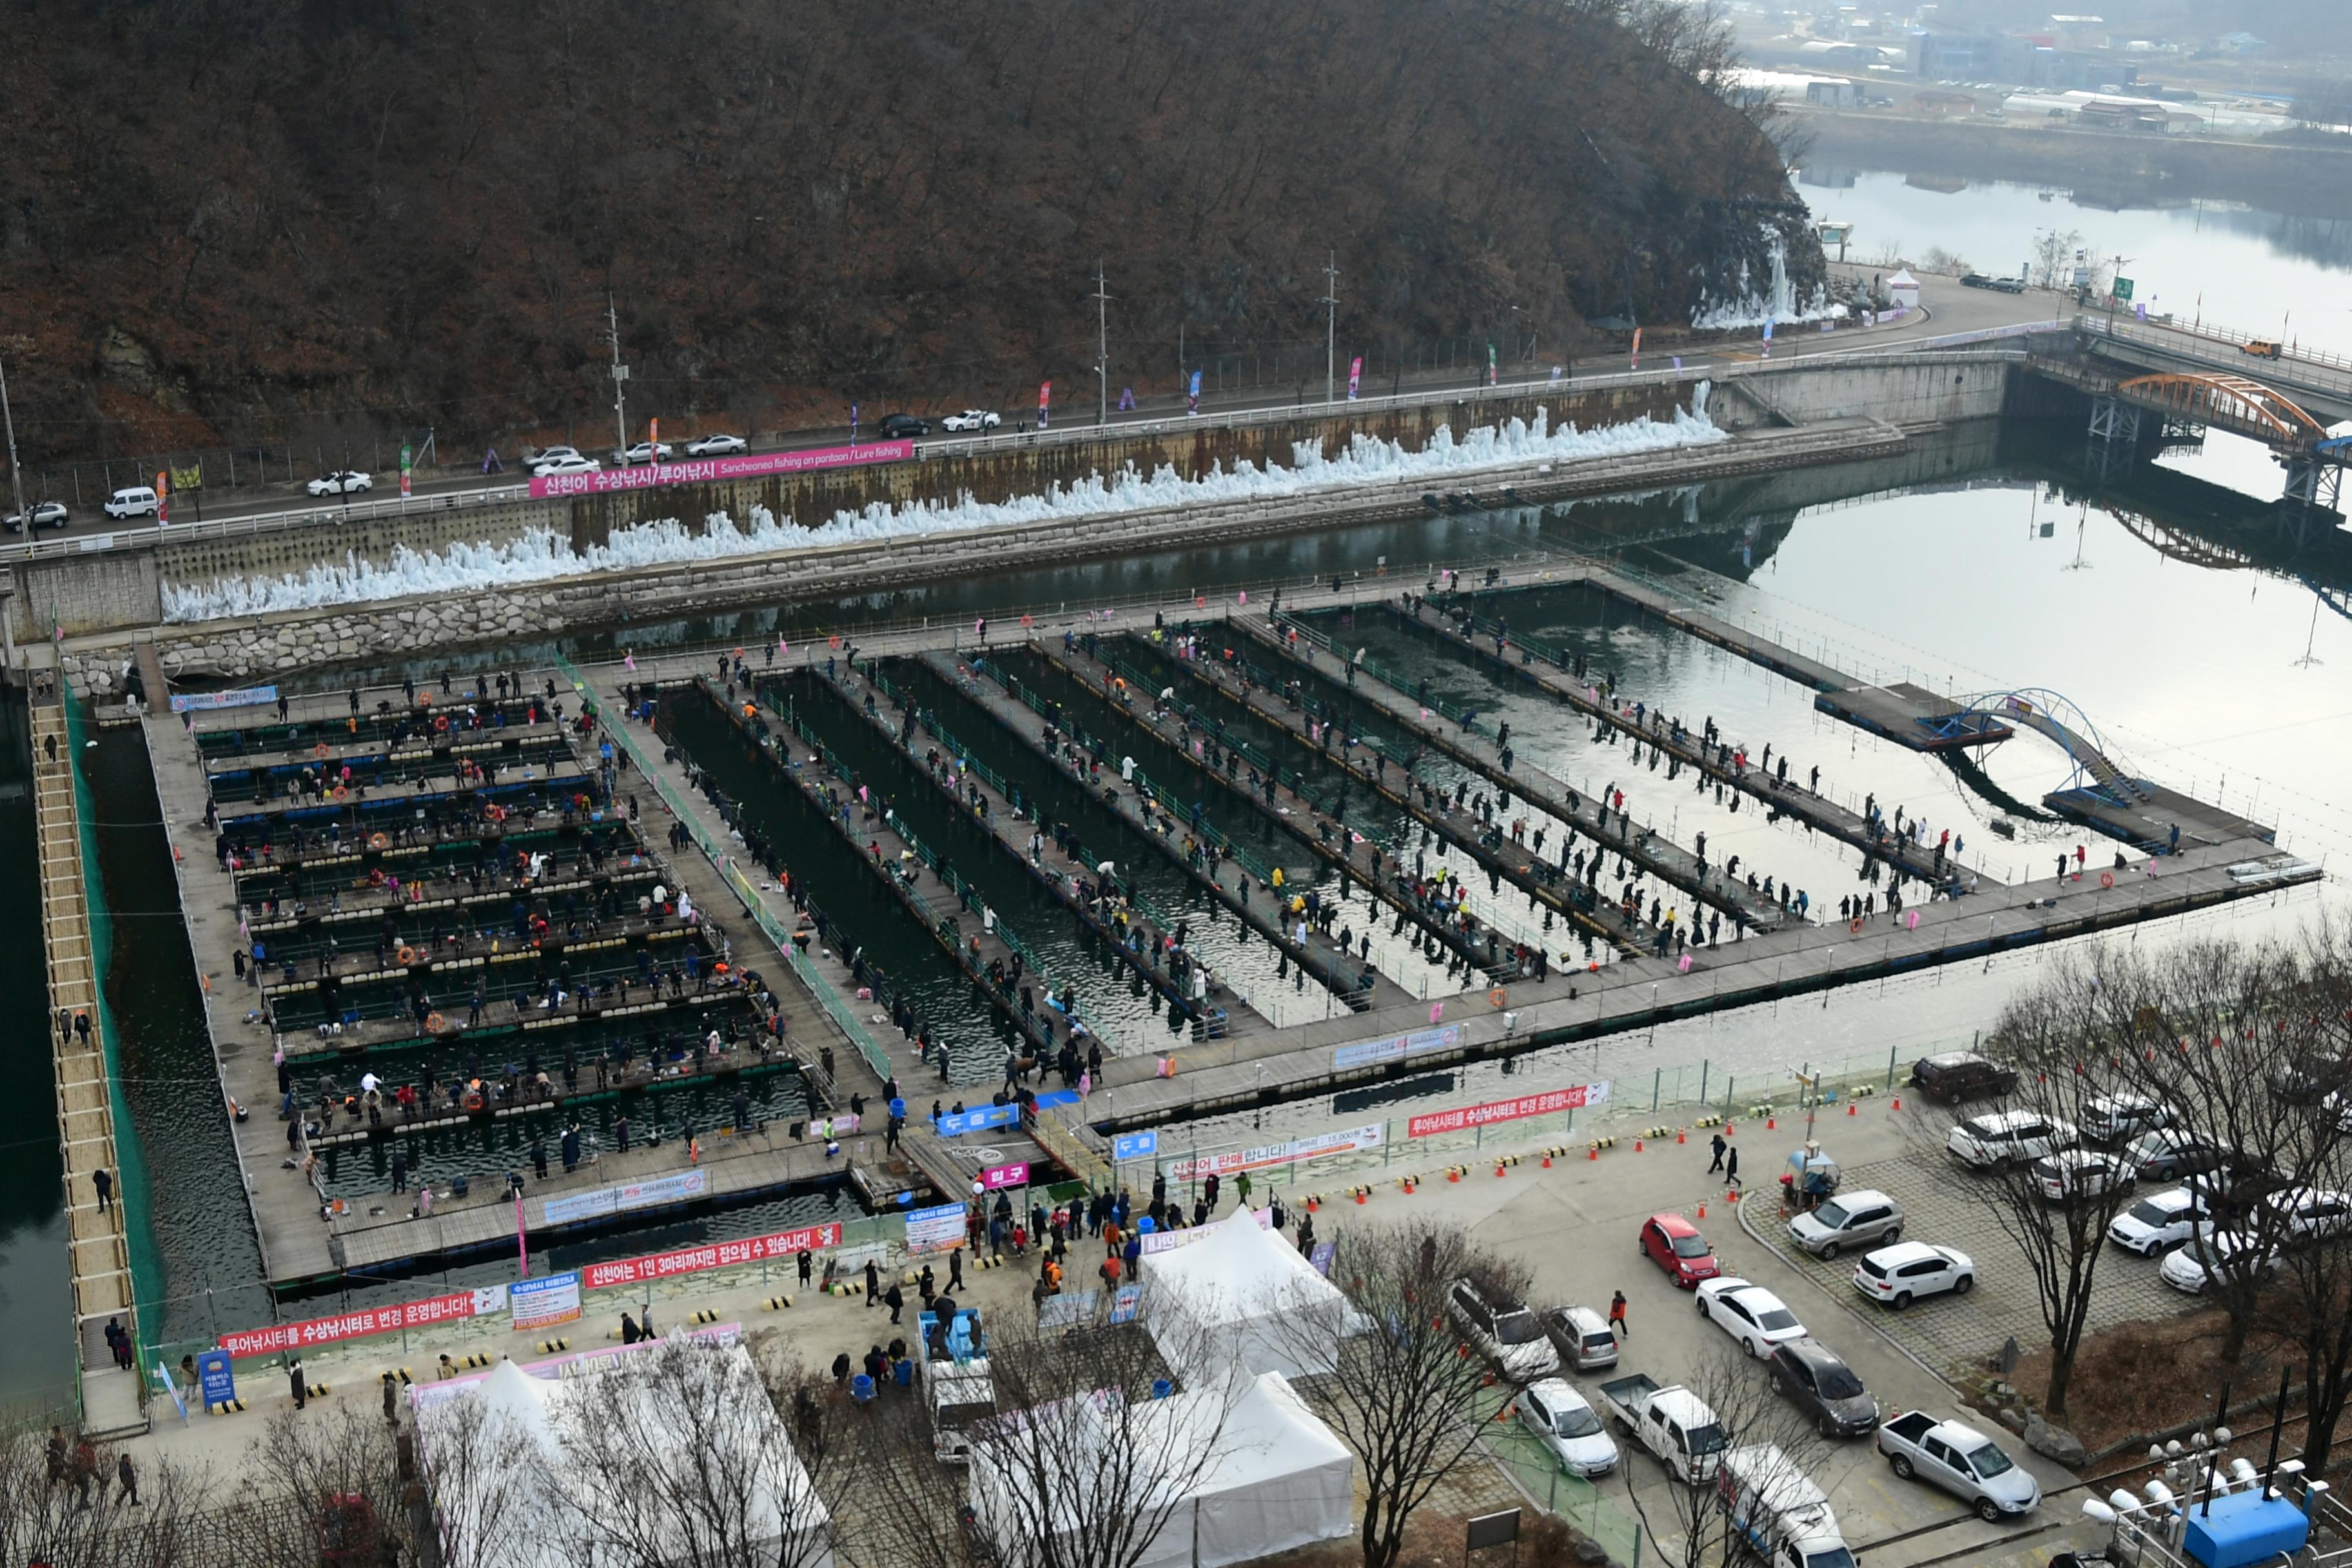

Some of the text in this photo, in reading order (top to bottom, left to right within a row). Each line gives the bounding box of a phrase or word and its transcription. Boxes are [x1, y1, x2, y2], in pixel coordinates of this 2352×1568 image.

[721, 458, 773, 474] Sancheoneo
[774, 456, 802, 469] fishing
[803, 457, 814, 466] on
[815, 453, 849, 467] pontoon
[876, 446, 902, 458] fishing
[545, 474, 589, 495] 산천어
[1413, 1090, 1582, 1134] 루어낚시터를 수상낚시터로 변경 운영합니다!
[1171, 1158, 1211, 1177] 산천어
[1217, 1144, 1287, 1168] 판매합니다!
[592, 1230, 811, 1286] 산천어는 1인 3마리까지만 잡으실 수 있습니다!
[227, 1296, 469, 1355] 루어낚시터를 수상낚시터로 변경 운영합니다!
